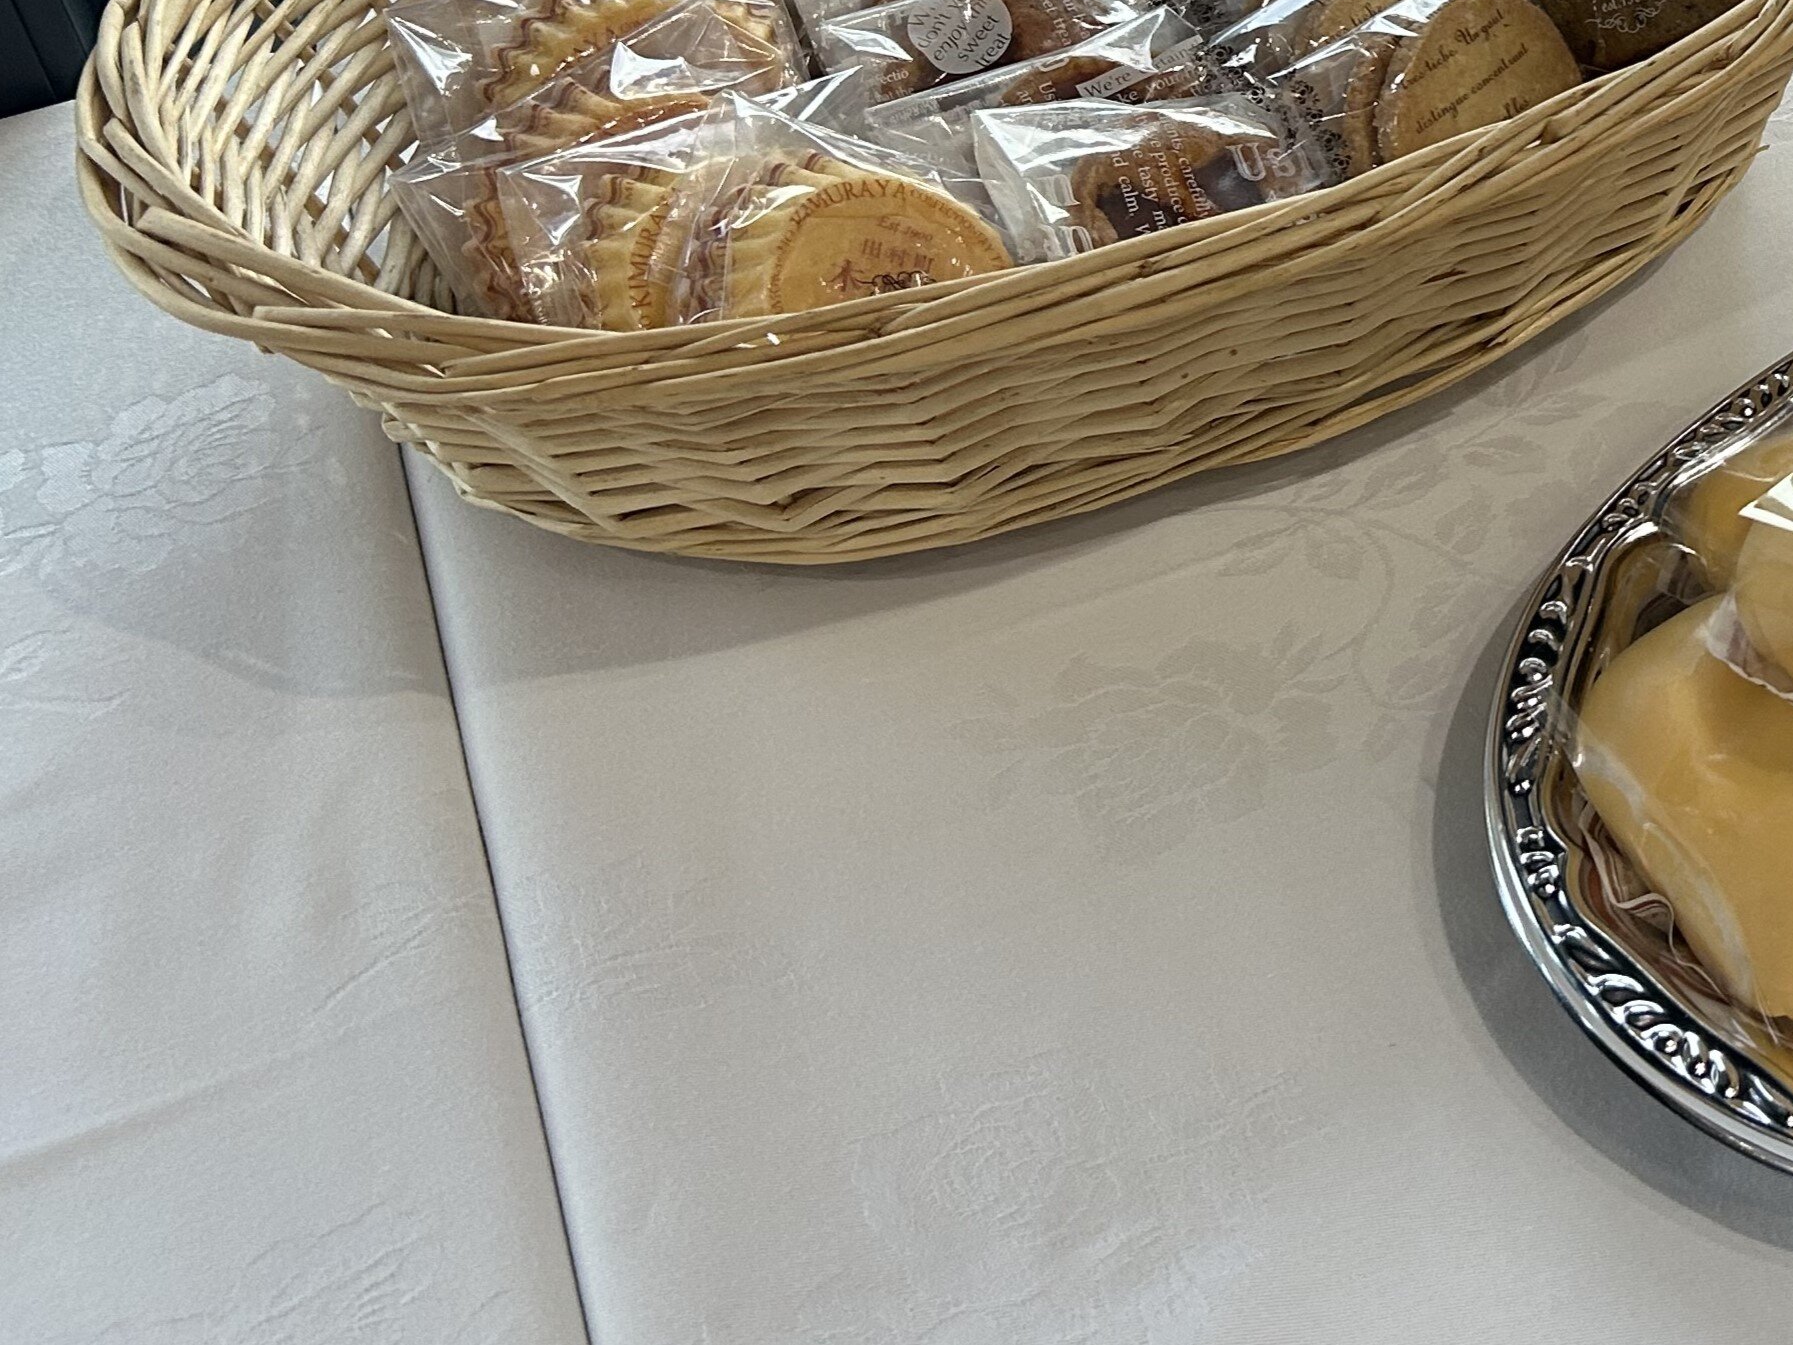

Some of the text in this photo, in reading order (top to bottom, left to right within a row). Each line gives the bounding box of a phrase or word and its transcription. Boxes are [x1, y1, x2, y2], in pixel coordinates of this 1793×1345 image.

[917, 12, 951, 49] don't
[932, 21, 968, 63] enjoy
[956, 14, 1000, 63] sweet
[1083, 70, 1132, 97] We're
[1118, 175, 1140, 217] calm.
[1137, 166, 1160, 203] tasty
[1149, 151, 1185, 214] produce
